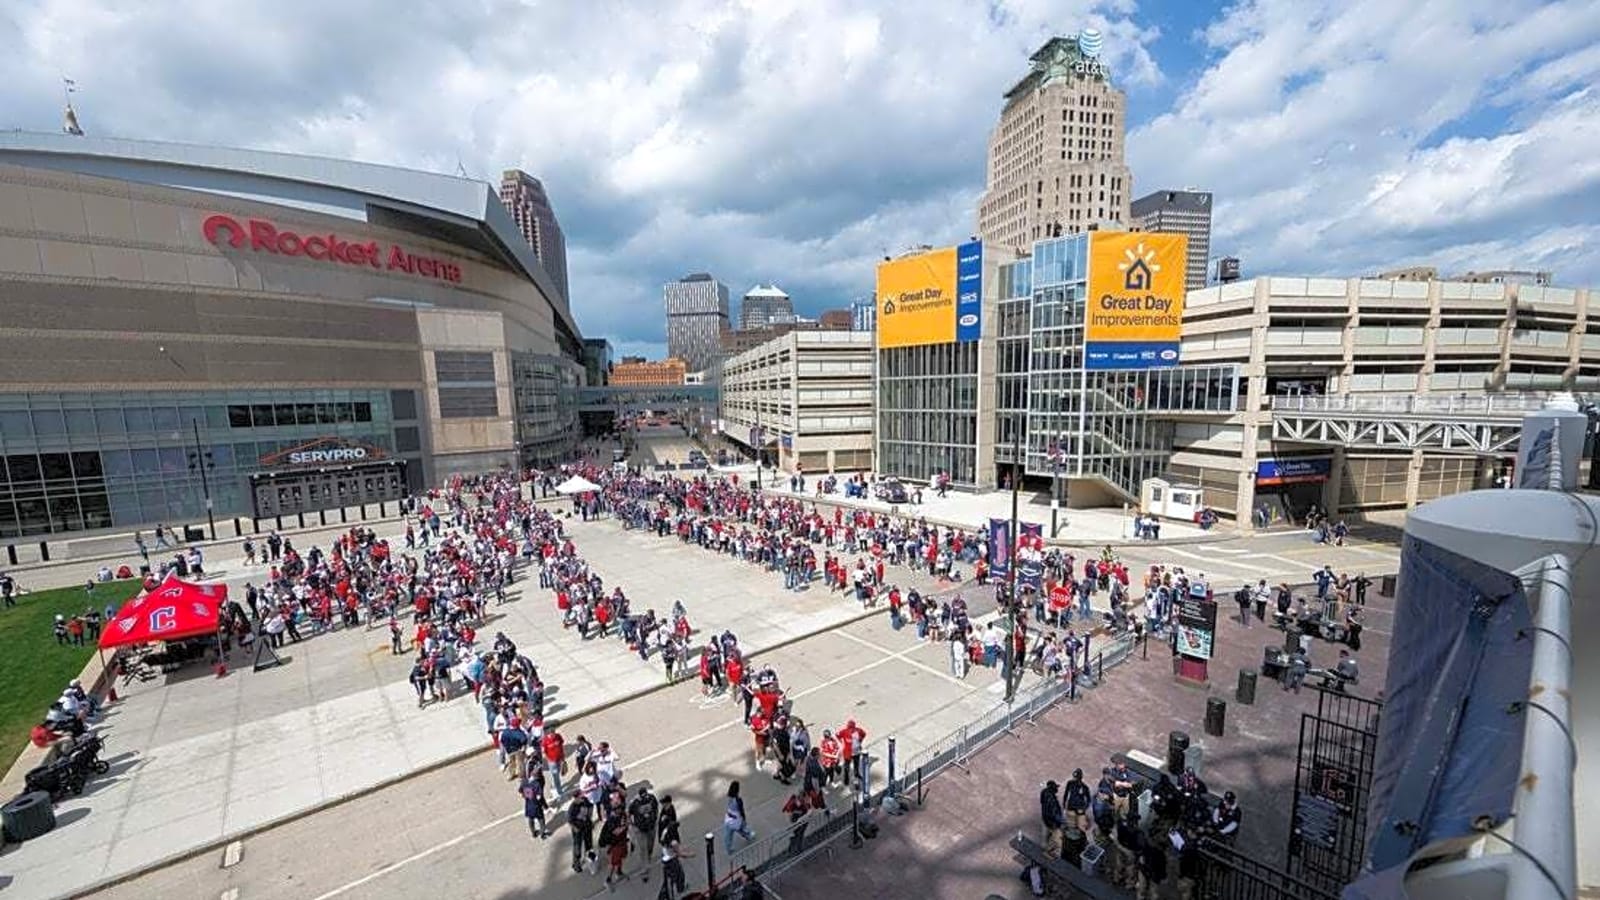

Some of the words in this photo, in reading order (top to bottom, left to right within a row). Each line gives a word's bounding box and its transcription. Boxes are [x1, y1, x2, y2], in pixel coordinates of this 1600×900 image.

[248, 217, 381, 270] Rocket
[387, 244, 462, 283] Arena
[900, 291, 923, 303] Great
[925, 288, 943, 300] Day
[1100, 294, 1141, 310] Great
[1145, 295, 1173, 313] Day
[900, 299, 952, 312] Improvements
[1092, 312, 1178, 328] Improvements
[290, 447, 366, 464] SERVPRO
[1049, 591, 1071, 604] STOP
